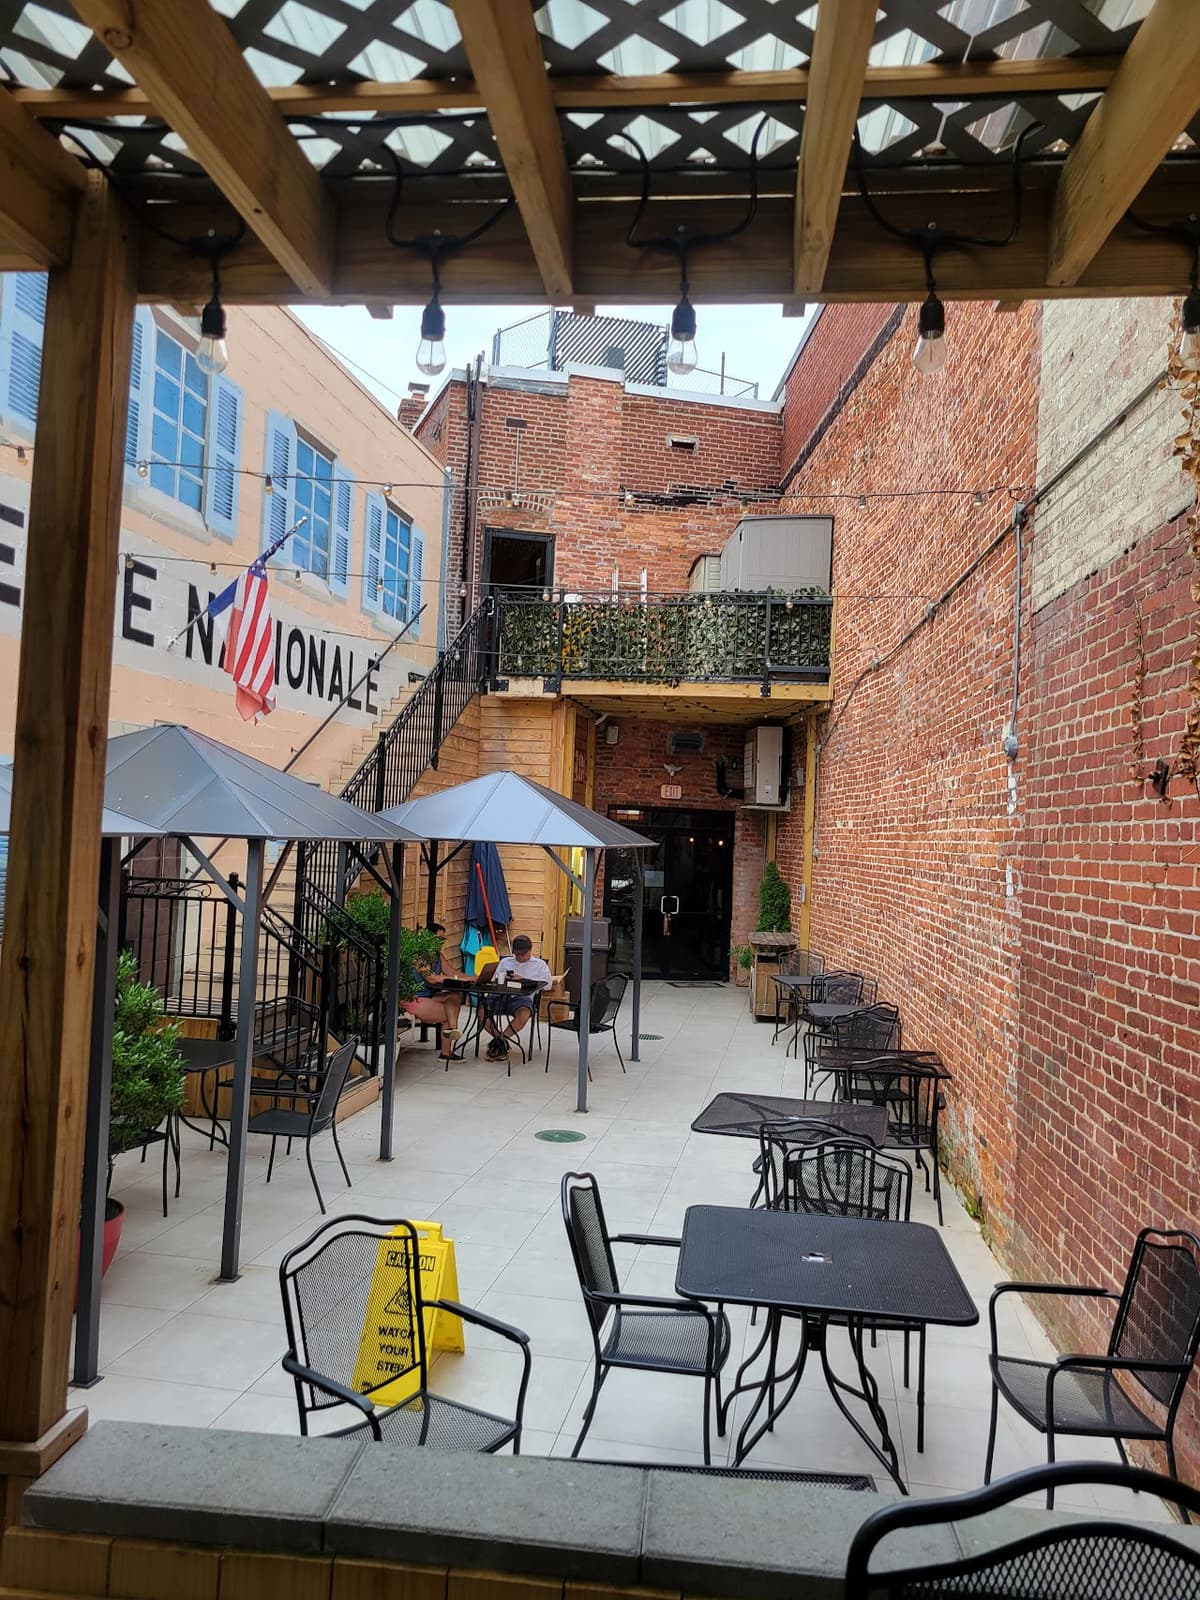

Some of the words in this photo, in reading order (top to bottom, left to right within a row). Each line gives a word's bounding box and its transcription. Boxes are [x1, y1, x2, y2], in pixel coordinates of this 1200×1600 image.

[186, 583, 380, 715] NIONALE
[664, 785, 679, 798] EXIT
[379, 1343, 408, 1357] YOUR
